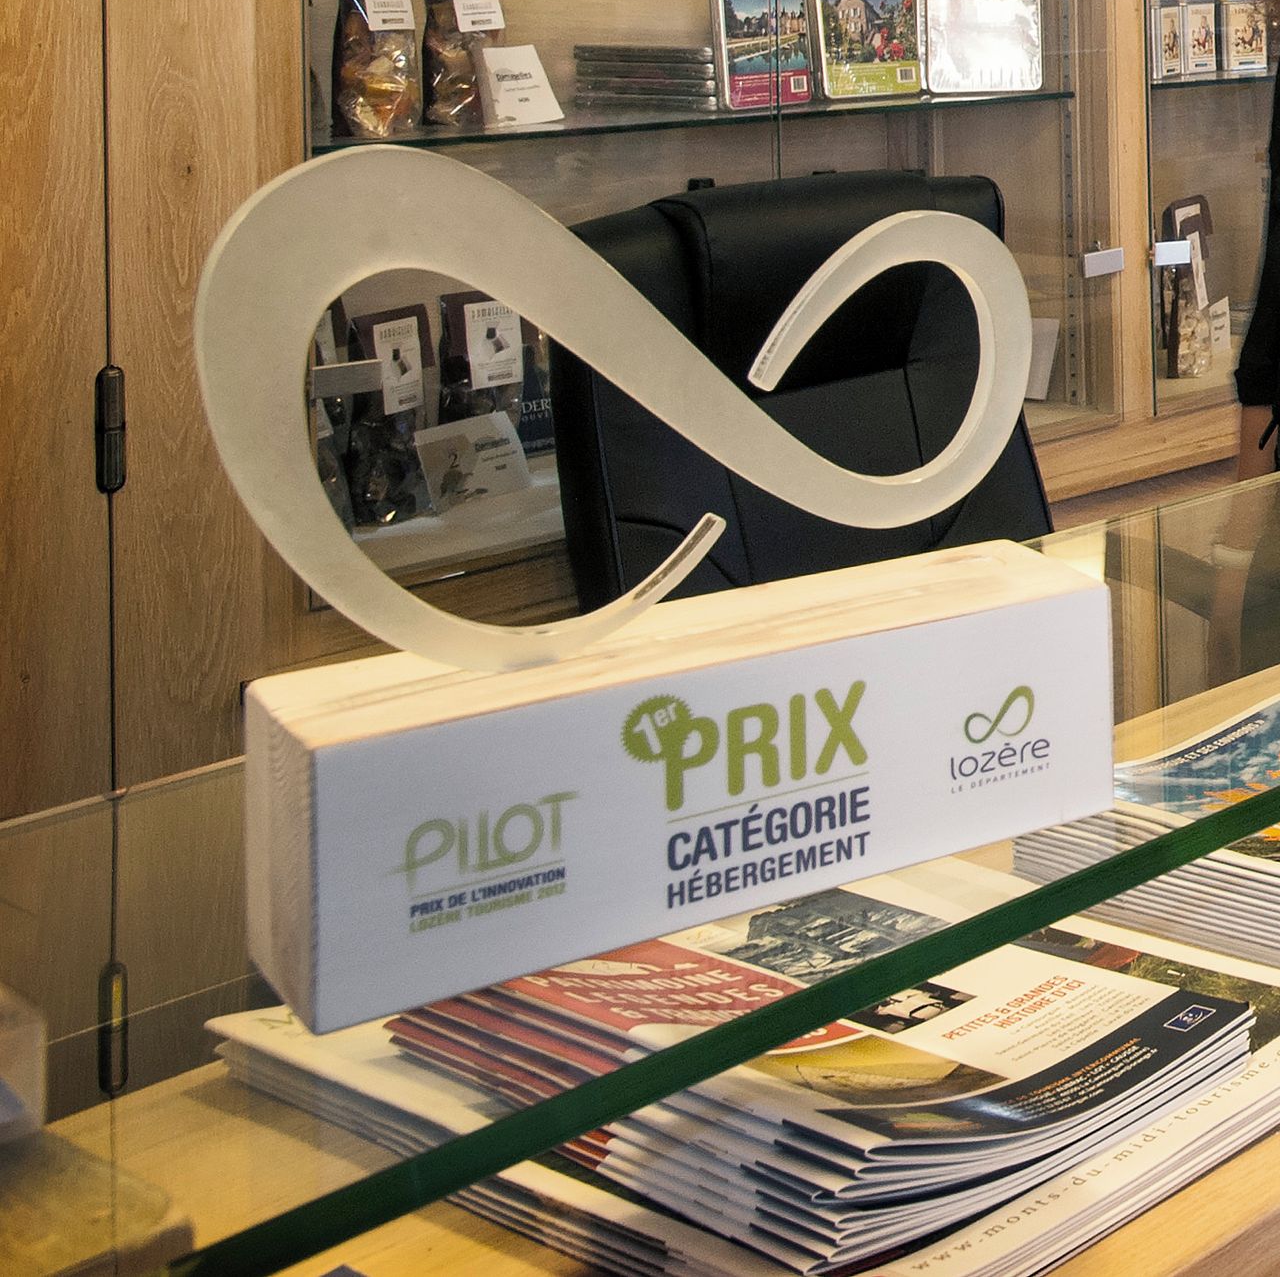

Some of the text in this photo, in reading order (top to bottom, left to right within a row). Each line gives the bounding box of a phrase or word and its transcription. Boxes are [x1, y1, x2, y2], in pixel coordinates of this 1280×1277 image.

[633, 702, 680, 755] 1er
[665, 680, 869, 812] PRIX
[951, 785, 963, 795] LE
[395, 791, 577, 892] PILOT
[667, 786, 871, 871] CATÉGORIE
[409, 866, 566, 918] PRIX DE L'INNOVATION
[667, 831, 871, 909] HÉBERGEMENT
[522, 967, 745, 993] PATRIMOINE
[941, 1009, 1001, 1040] PETITES
[1008, 975, 1069, 1009] GRANDES
[994, 979, 1087, 1029] HISTOIRE D'ICI
